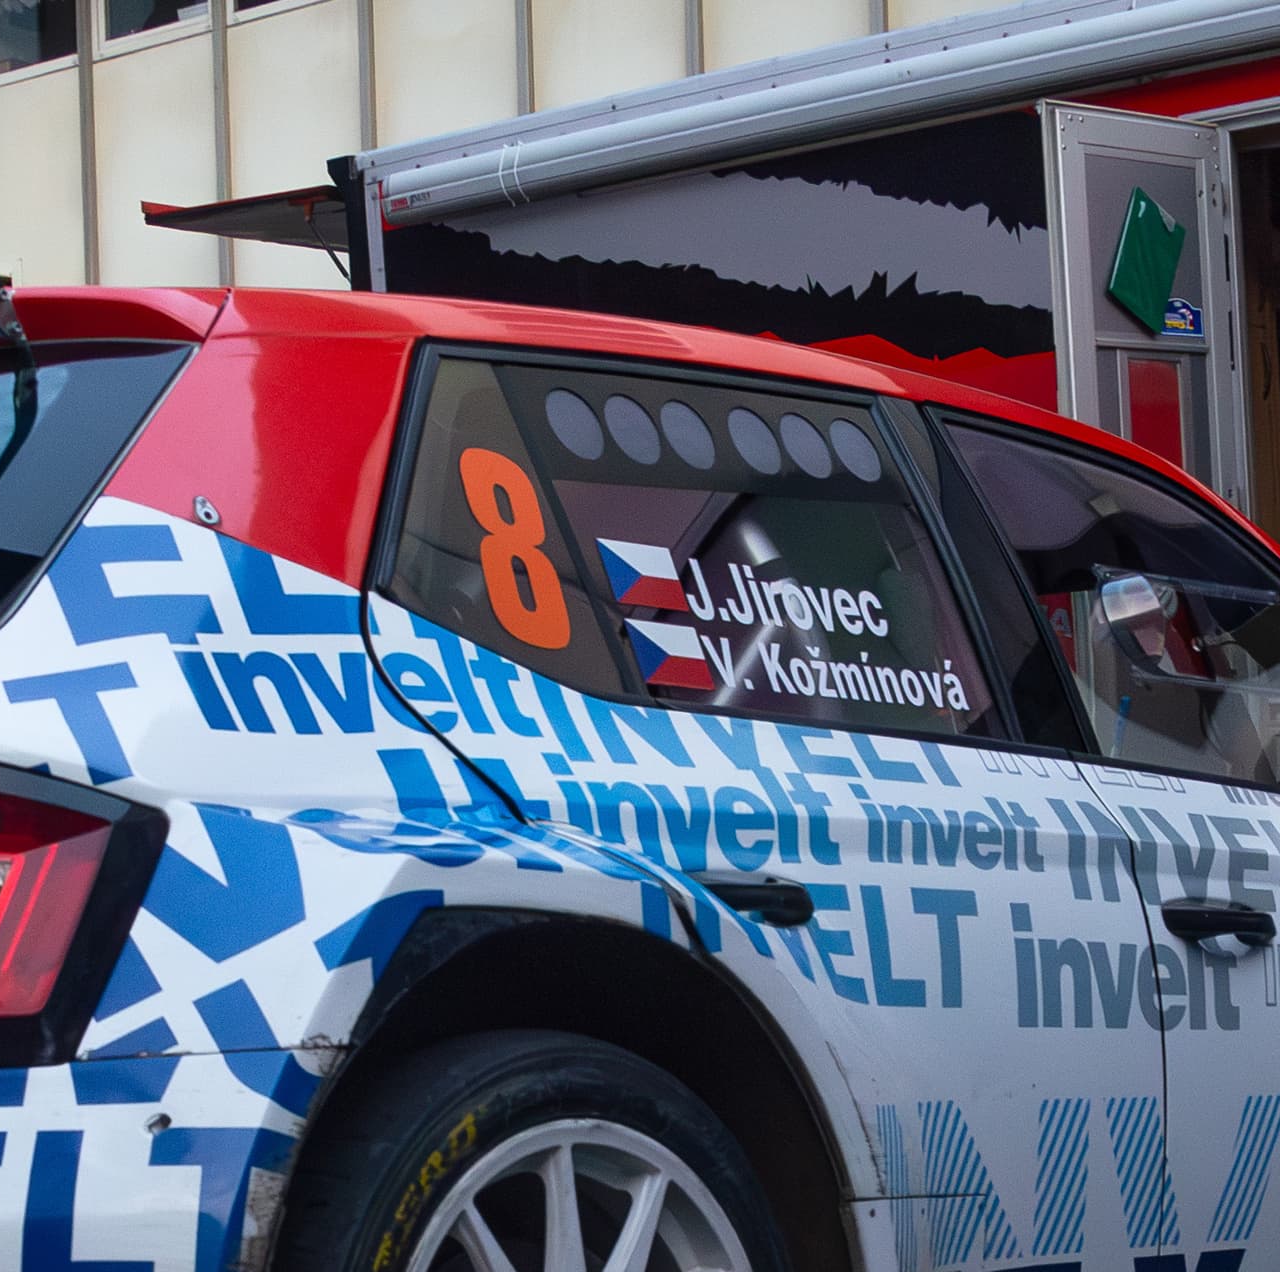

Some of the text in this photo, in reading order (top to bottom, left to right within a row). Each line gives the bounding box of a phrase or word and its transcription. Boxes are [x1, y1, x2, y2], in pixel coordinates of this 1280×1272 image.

[459, 447, 571, 650] 8
[686, 557, 889, 637] J.Jirovec
[166, 618, 546, 737] invelt
[532, 676, 963, 787] INVELT
[758, 642, 970, 711] Kožmínová
[540, 752, 842, 872] invelt
[848, 783, 1046, 872] invelt
[1009, 902, 1241, 1031] invelt
